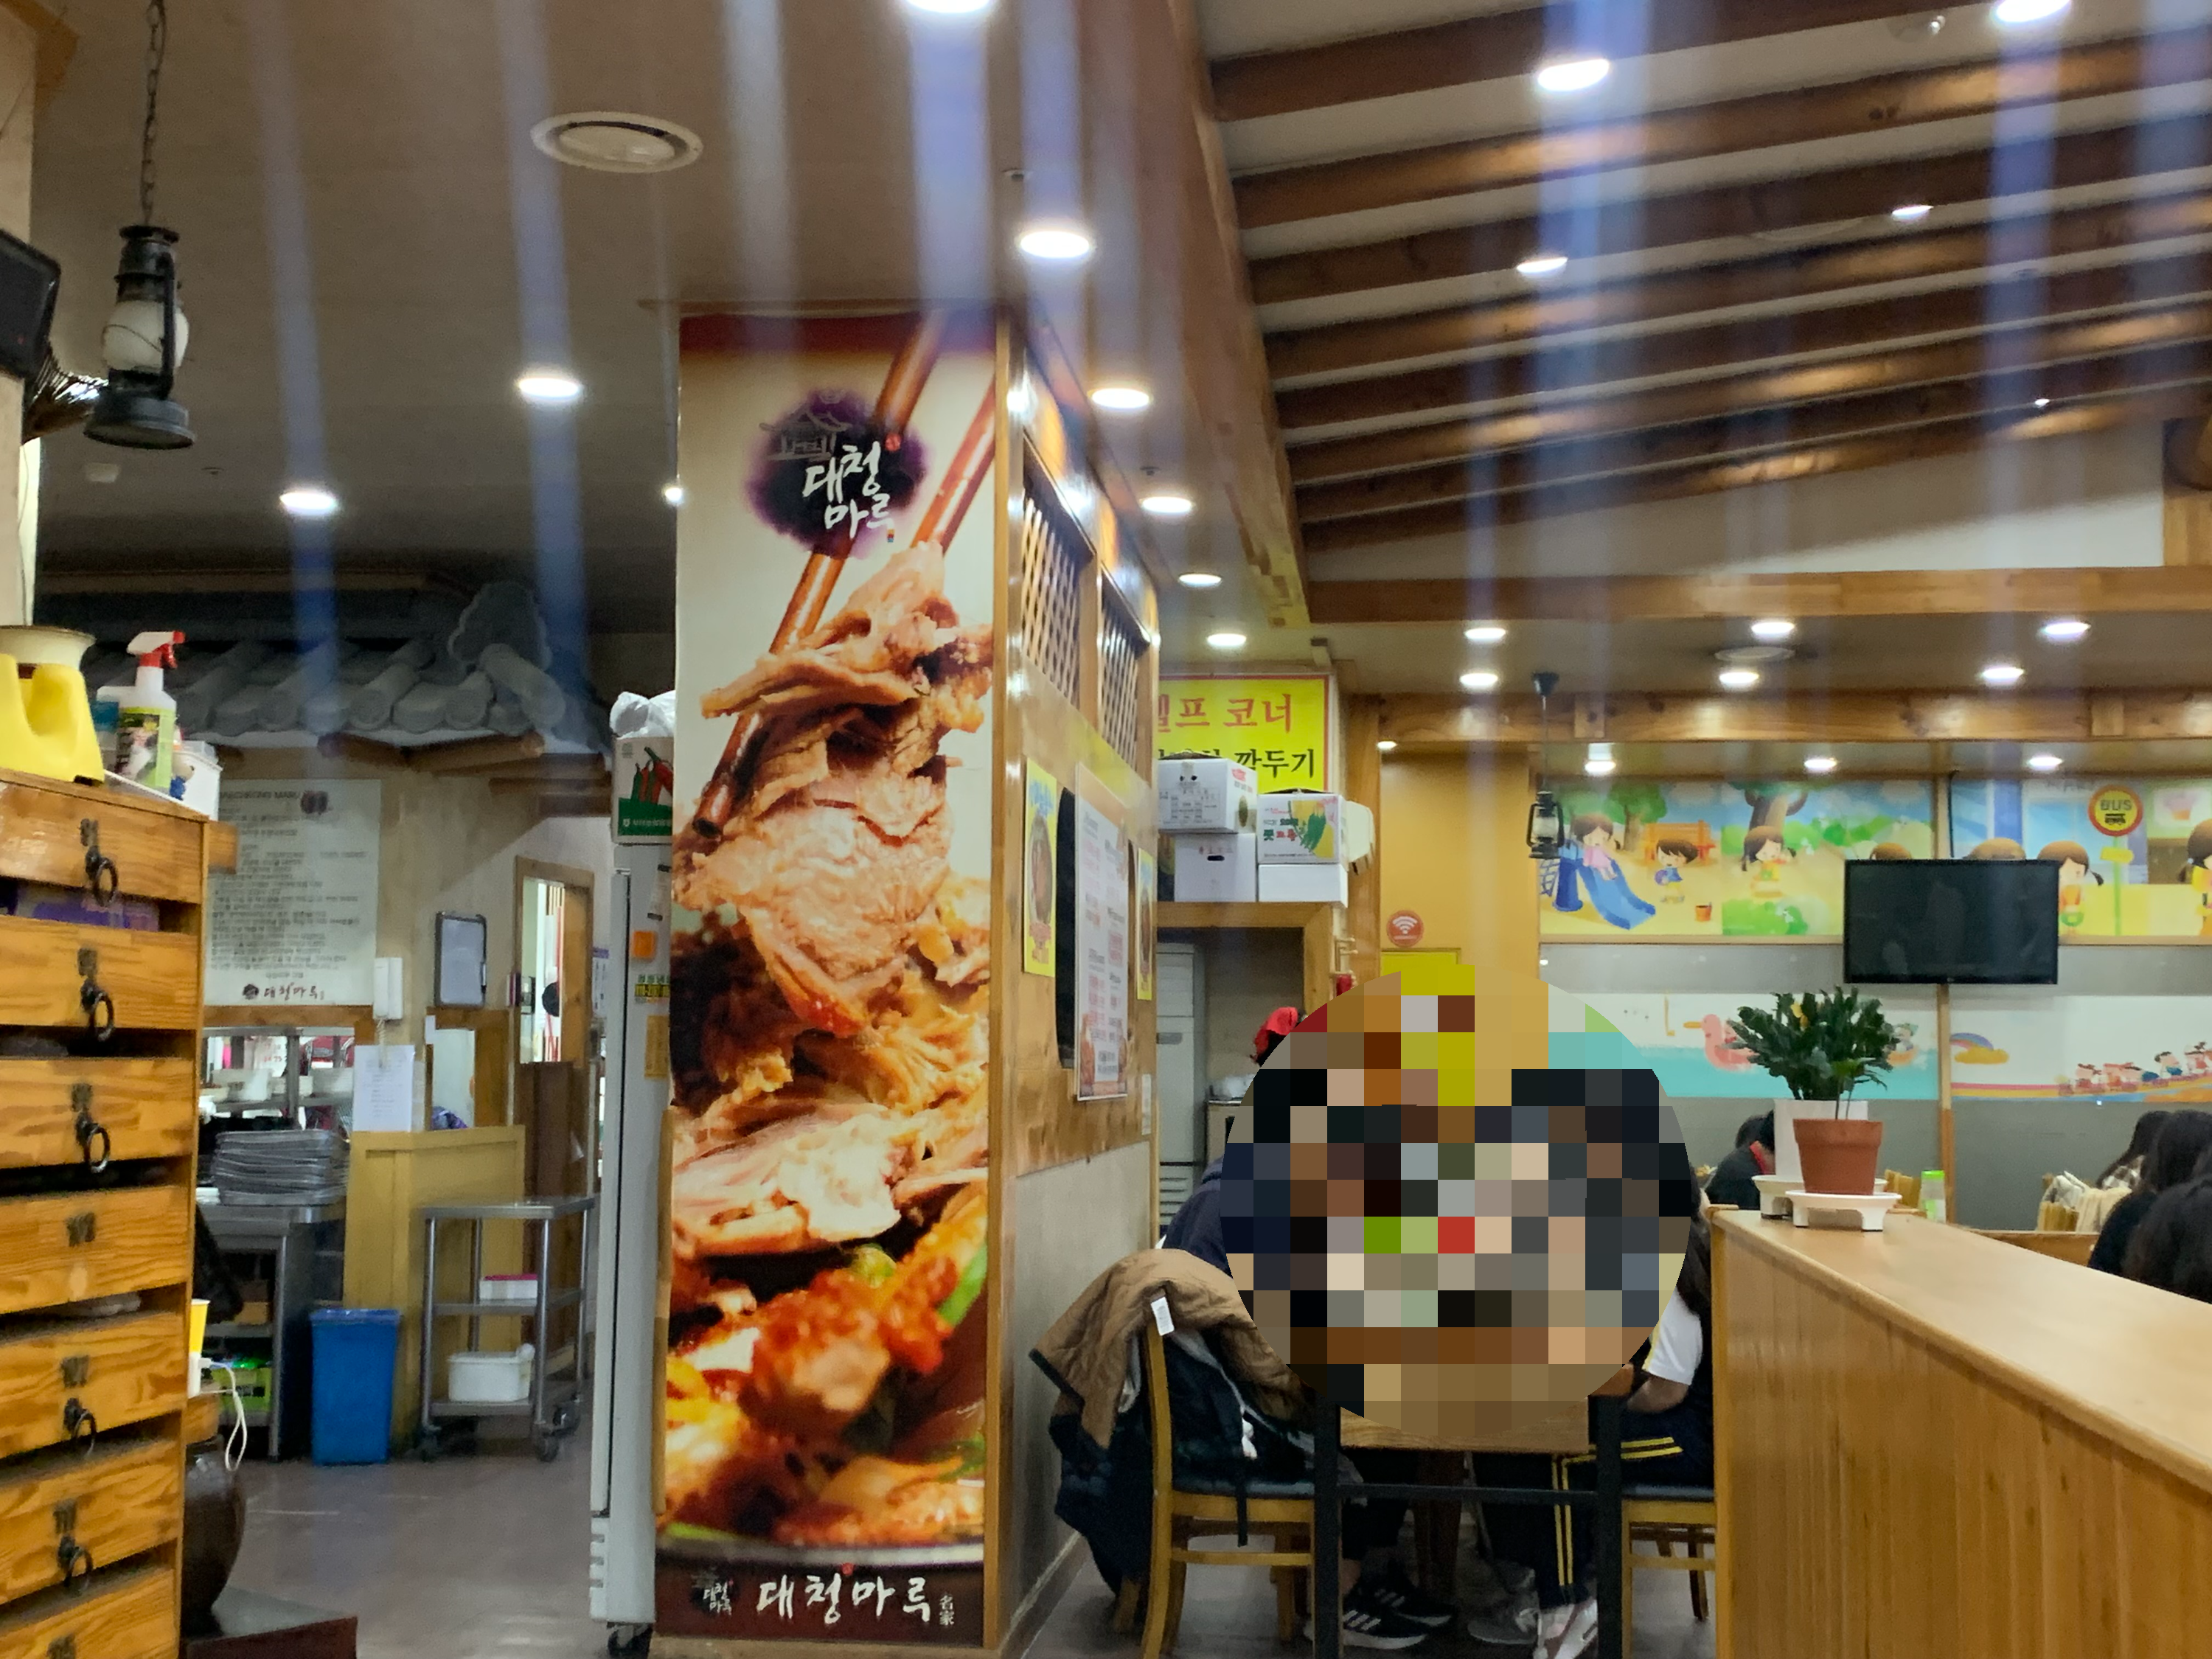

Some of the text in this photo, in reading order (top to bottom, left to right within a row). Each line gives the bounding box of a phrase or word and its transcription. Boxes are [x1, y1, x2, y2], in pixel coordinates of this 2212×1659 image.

[802, 441, 881, 504] 대청
[1223, 693, 1292, 733] 코너
[1234, 748, 1315, 779] 깍두기
[2100, 799, 2132, 810] BUS
